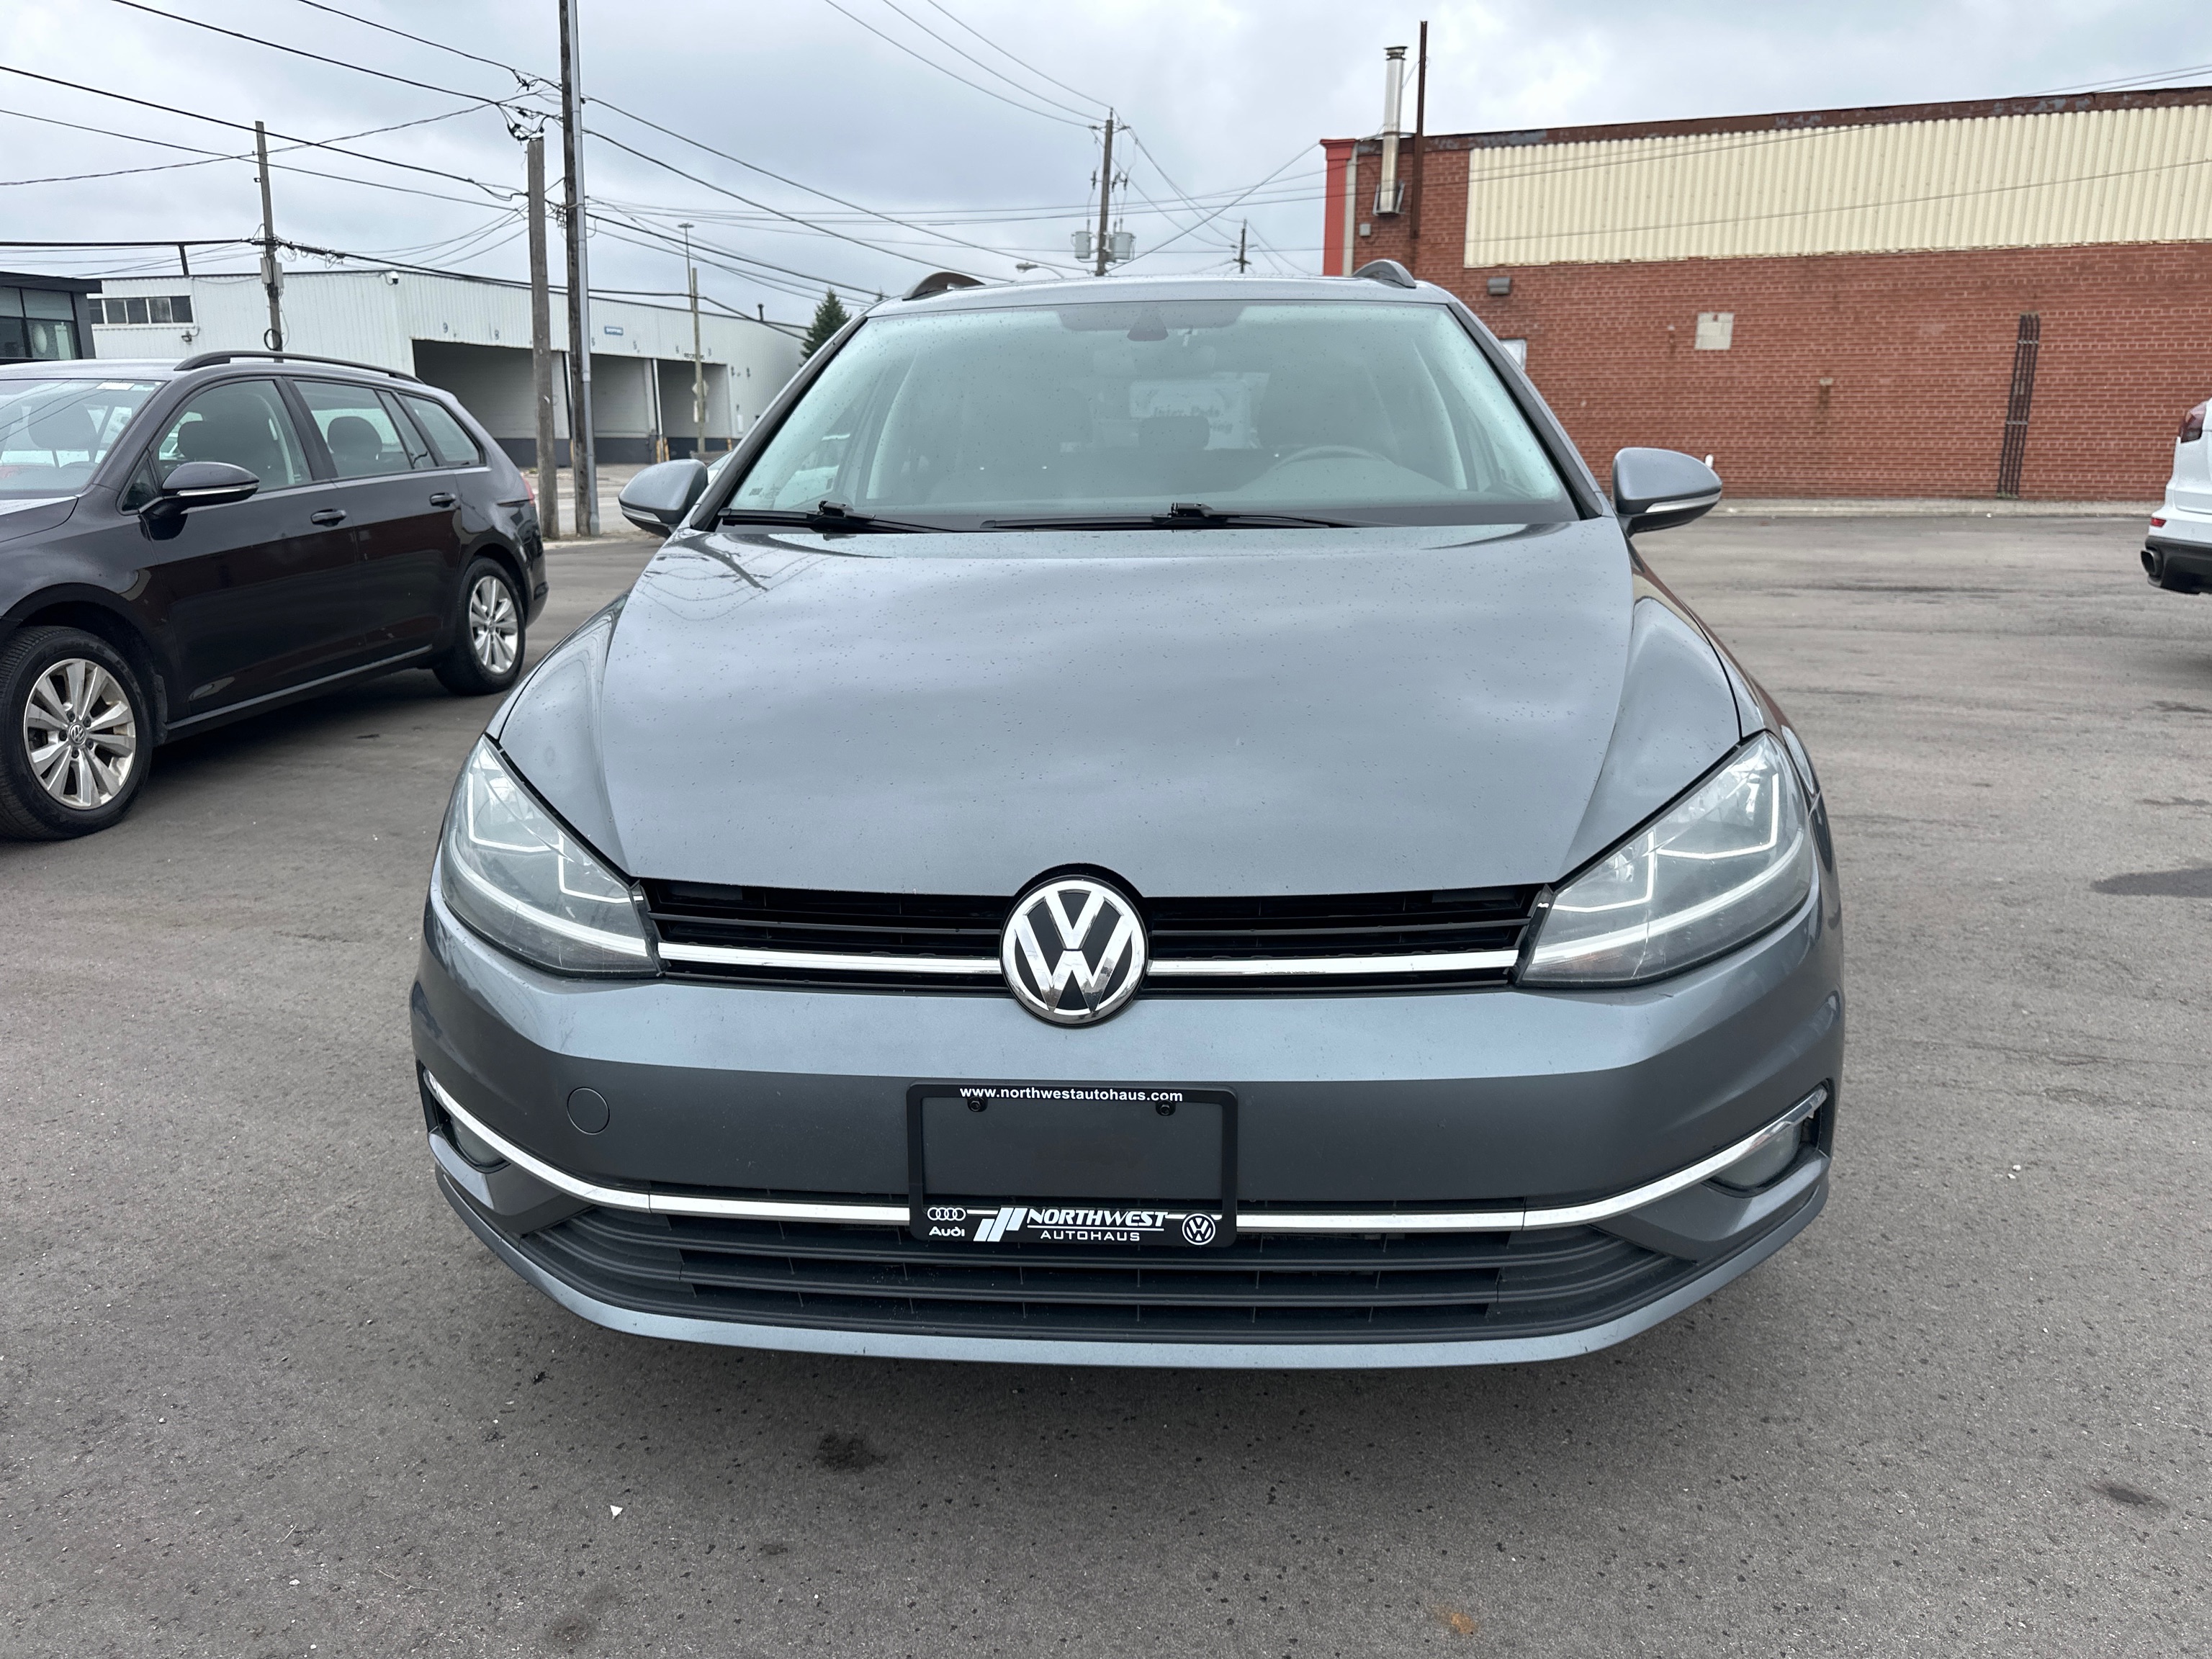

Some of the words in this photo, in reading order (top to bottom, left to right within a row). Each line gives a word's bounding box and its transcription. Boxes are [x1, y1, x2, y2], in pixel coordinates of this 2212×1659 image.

[1007, 884, 1140, 1018] VW
[960, 1087, 1183, 1102] www.northwestautohaus.com
[1027, 1208, 1168, 1227] NORTHWEST
[929, 1226, 966, 1237] Audi
[1040, 1230, 1141, 1241] AUTOHAUS
